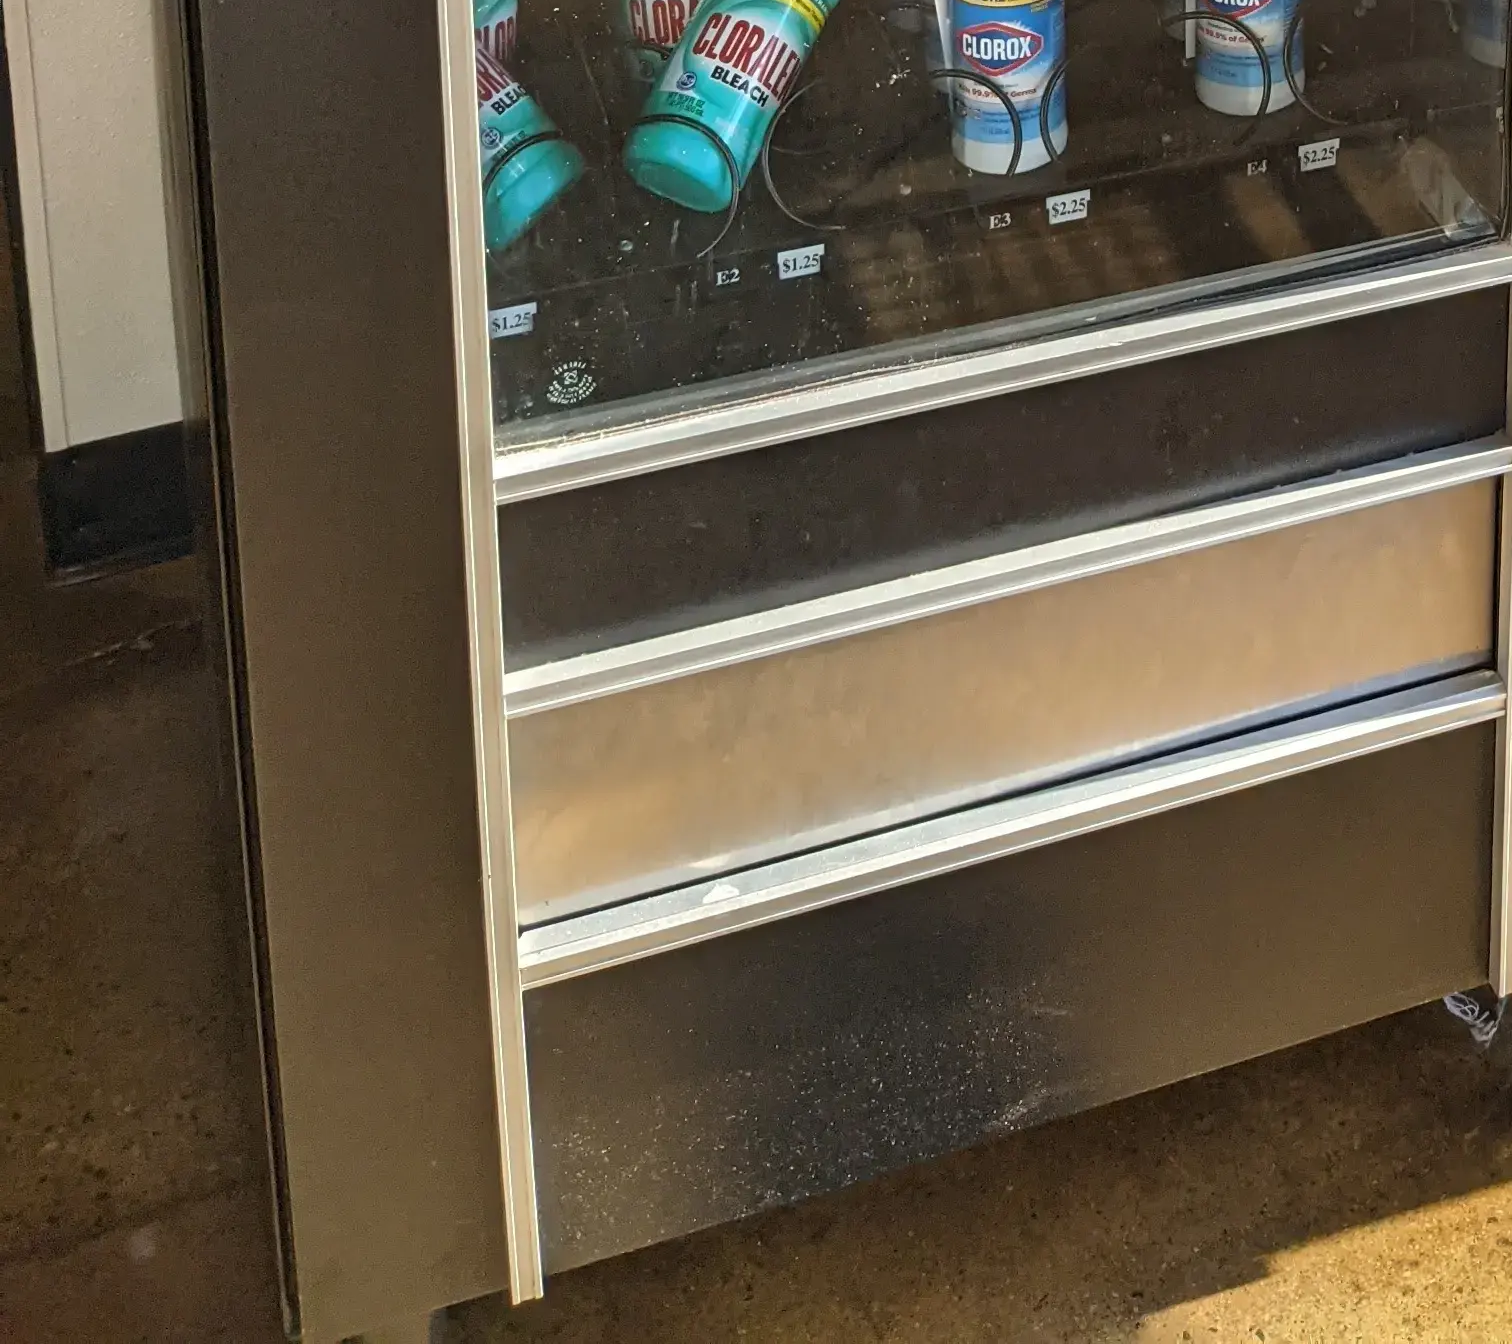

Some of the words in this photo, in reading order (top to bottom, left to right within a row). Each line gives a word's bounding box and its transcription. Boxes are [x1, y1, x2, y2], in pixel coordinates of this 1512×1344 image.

[962, 33, 1032, 61] CLOROX
[710, 65, 770, 108] BLEACH
[1247, 158, 1268, 175] E4
[1303, 147, 1335, 166] $2.25
[1050, 197, 1087, 218] $2.25
[989, 213, 1012, 230] E3
[782, 253, 819, 274] $1.25
[716, 268, 740, 286] E2
[491, 312, 531, 334] $1.25
